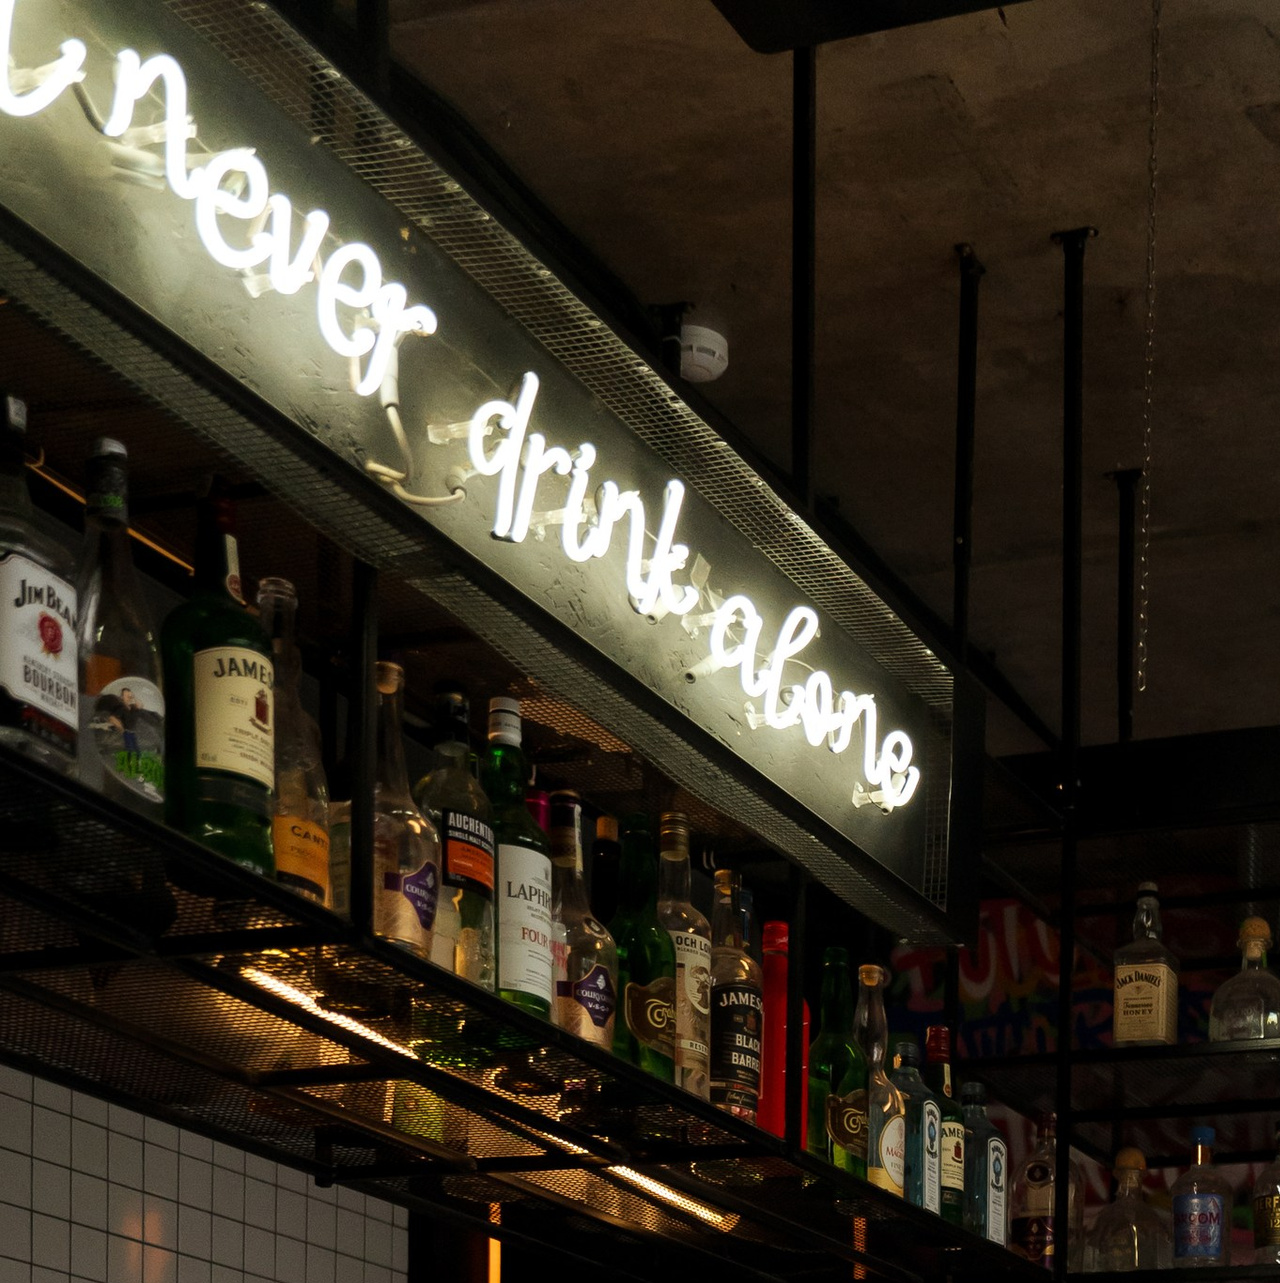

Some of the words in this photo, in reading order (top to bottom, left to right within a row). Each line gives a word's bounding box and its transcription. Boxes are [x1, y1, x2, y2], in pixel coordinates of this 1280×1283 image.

[103, 48, 438, 397] never
[468, 371, 700, 621] drink
[708, 604, 921, 811] alone
[1116, 973, 1134, 990] JACK
[1122, 1008, 1154, 1016] HONEY
